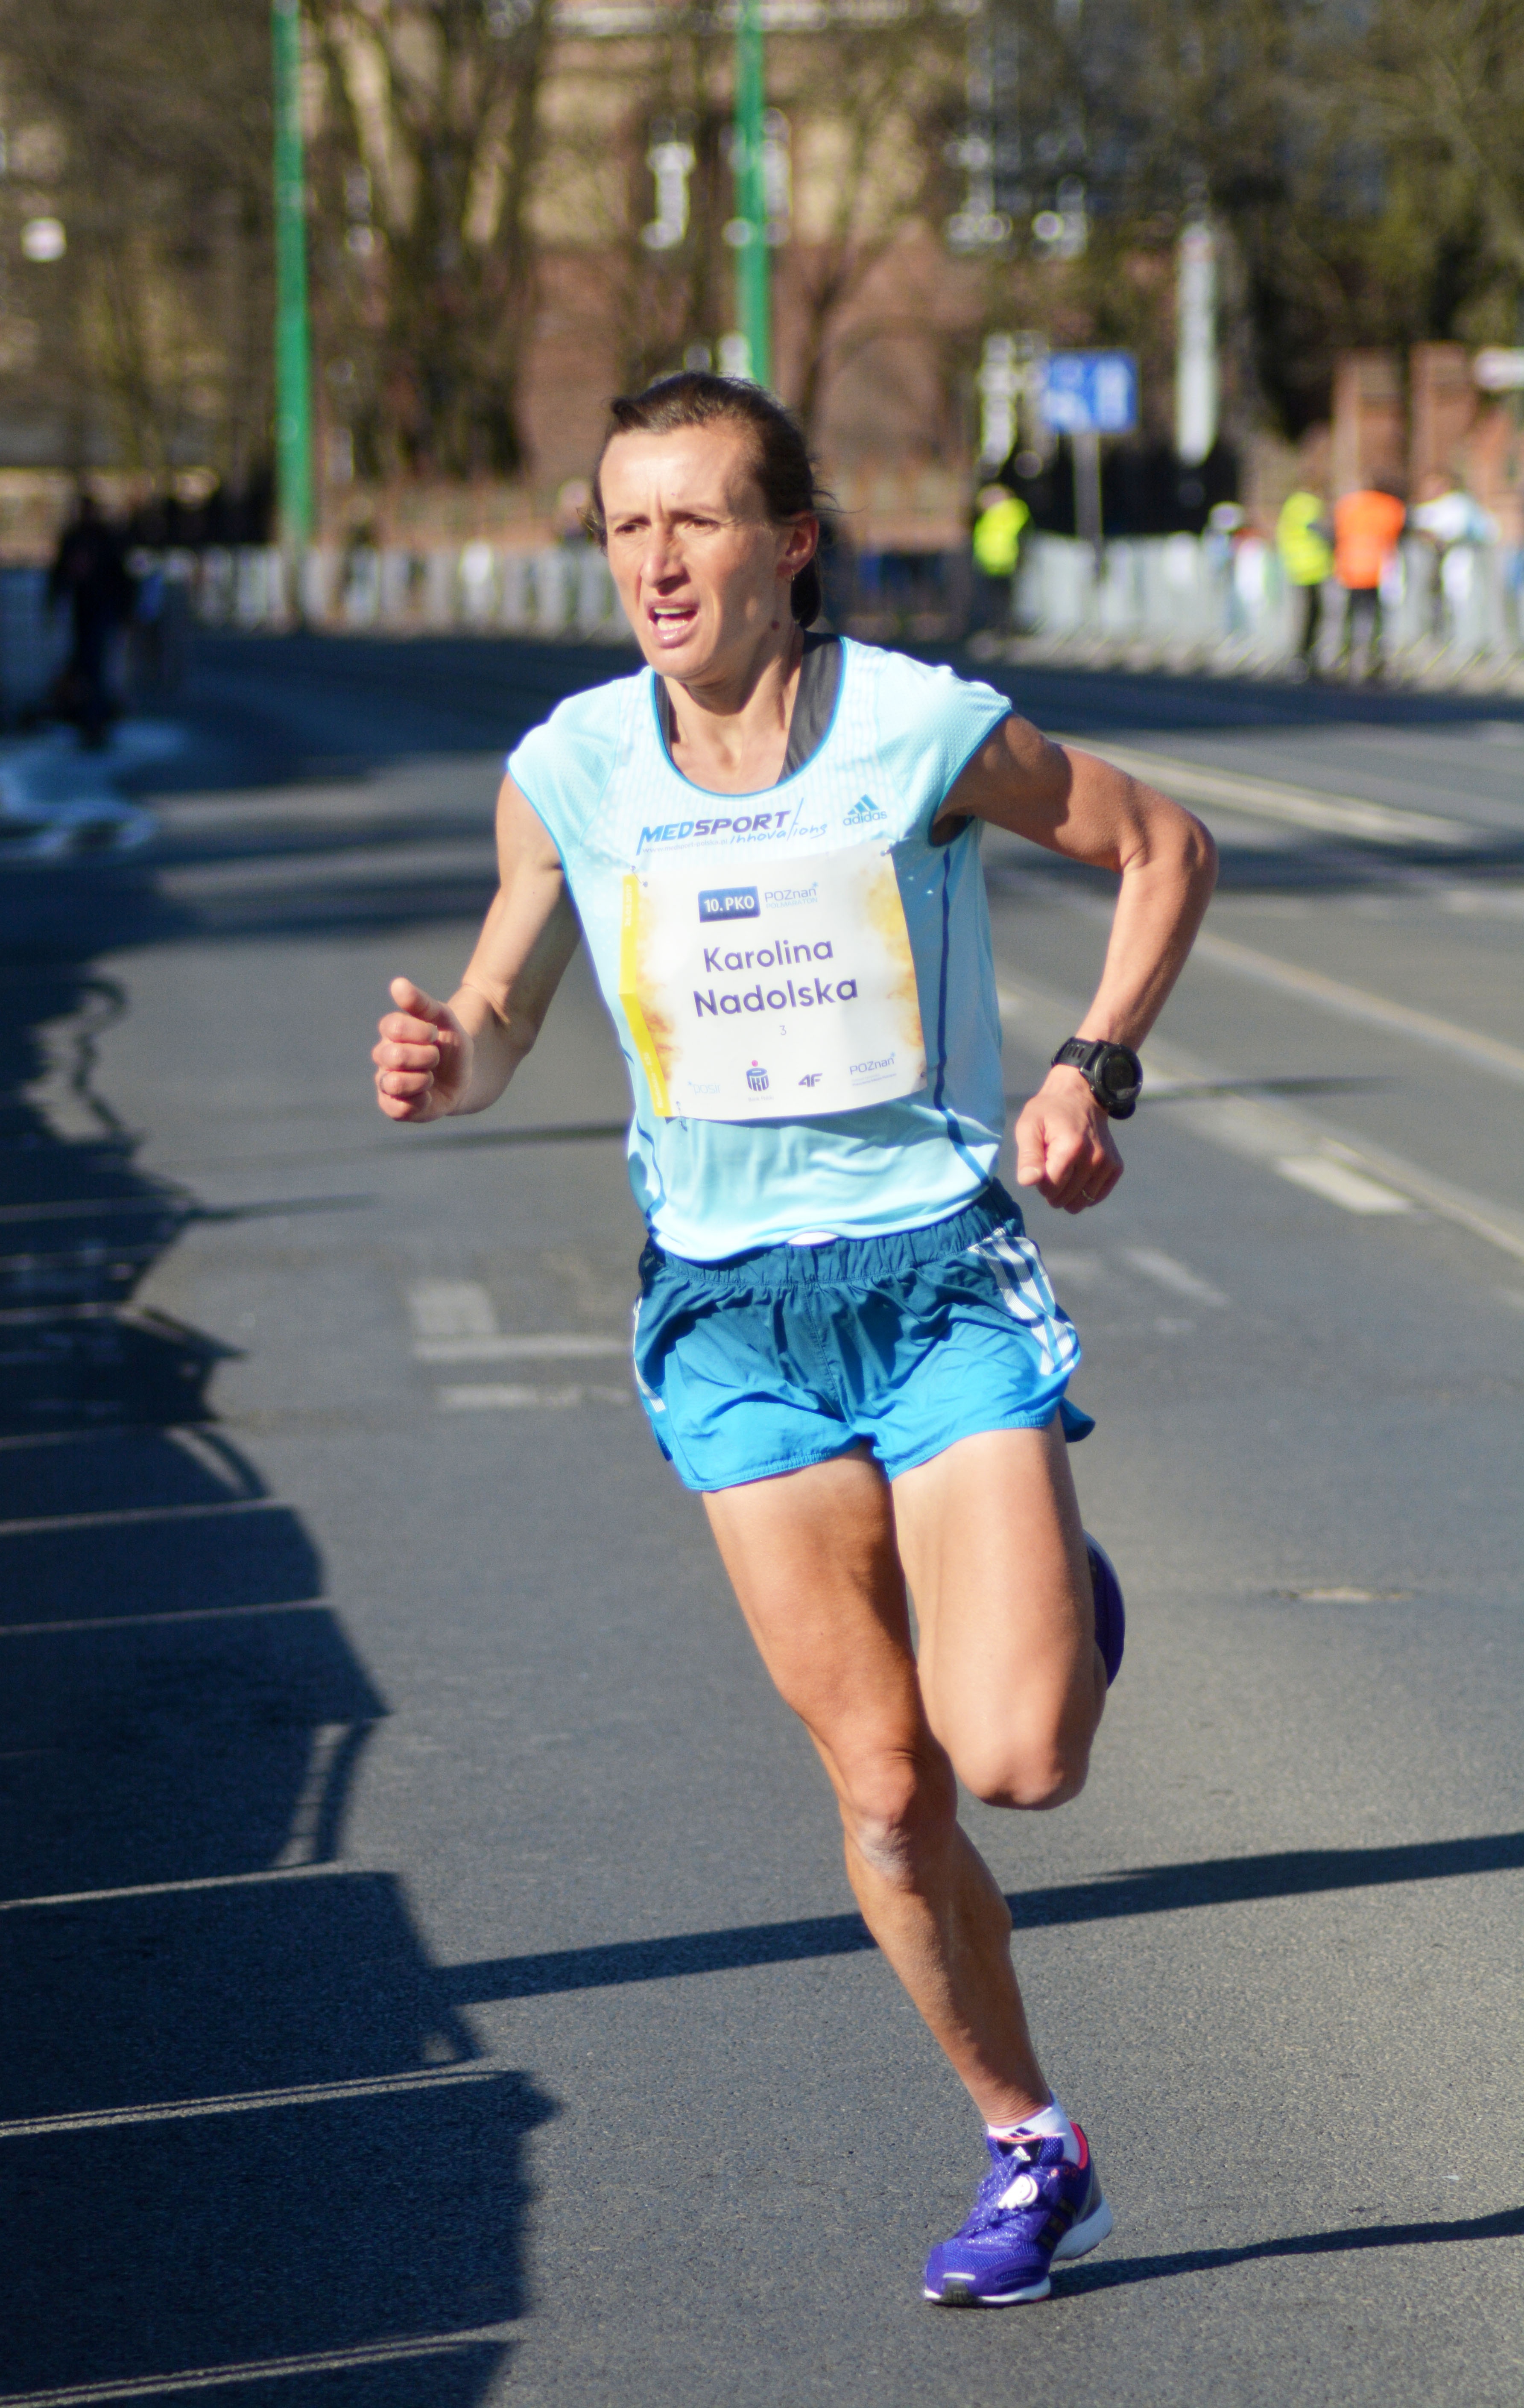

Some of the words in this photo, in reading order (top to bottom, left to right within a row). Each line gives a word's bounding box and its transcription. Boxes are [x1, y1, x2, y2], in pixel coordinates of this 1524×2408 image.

[843, 811, 887, 826] adidas
[637, 810, 792, 855] MEDSPORT
[642, 839, 728, 853] www.medsport-polska.pl
[725, 895, 755, 911] PKO
[703, 940, 833, 973] Karolina
[693, 978, 858, 1017] Nadolska
[779, 1026, 787, 1035] 3
[799, 1073, 822, 1087] 4F
